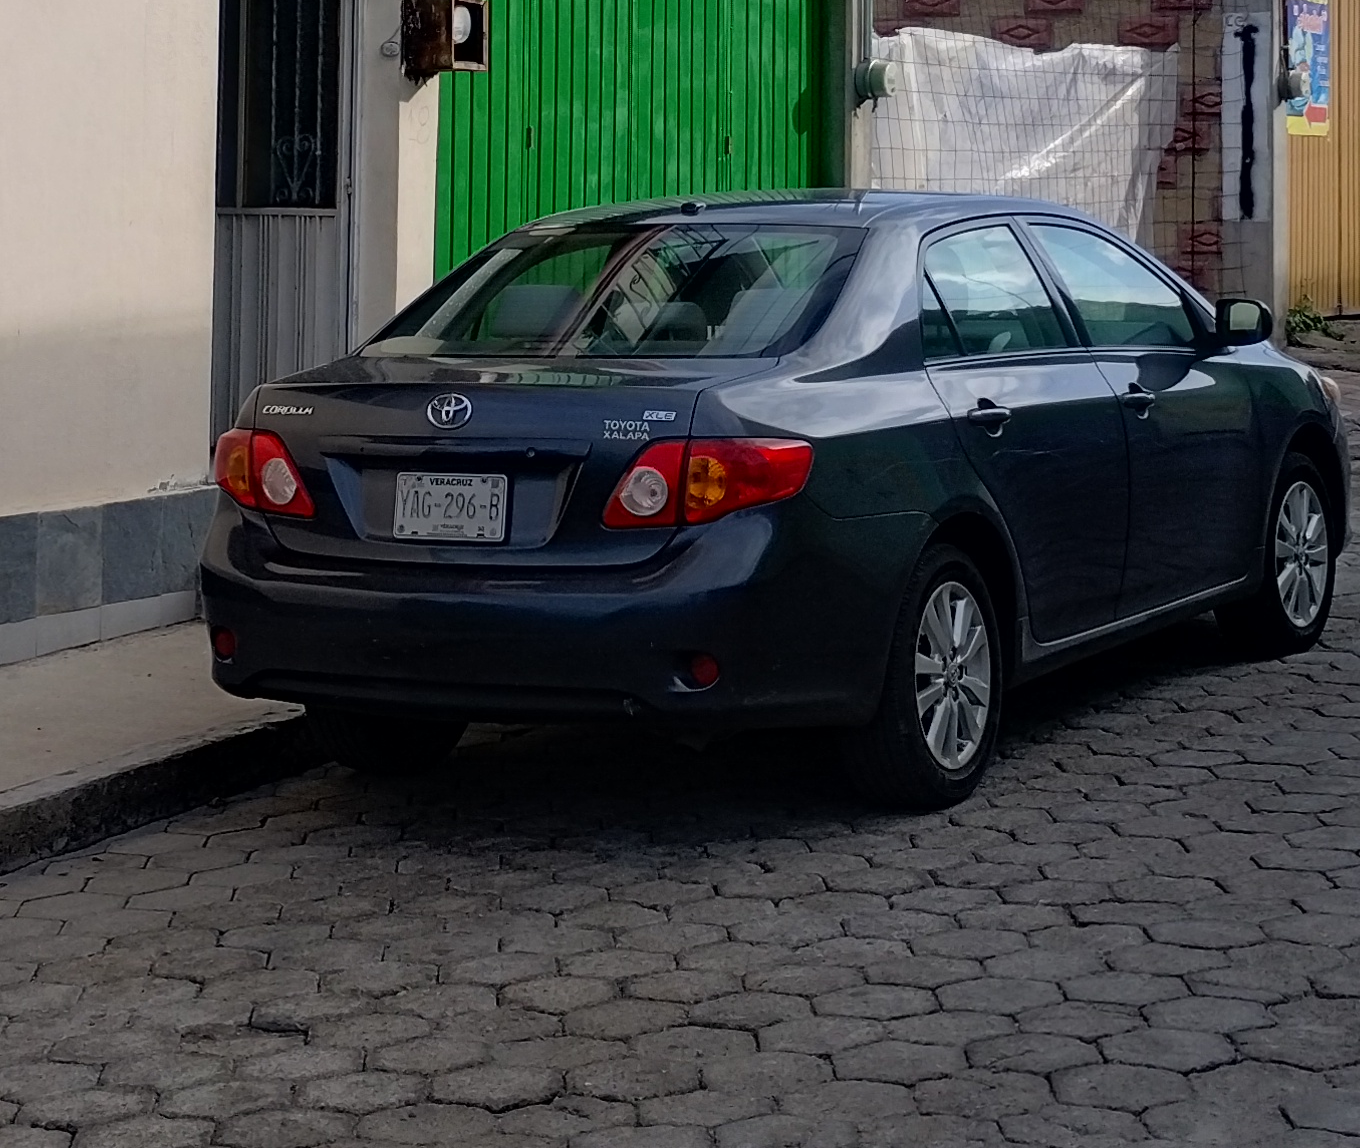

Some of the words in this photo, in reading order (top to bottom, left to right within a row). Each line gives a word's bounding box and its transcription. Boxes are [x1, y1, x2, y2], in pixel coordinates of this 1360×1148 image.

[645, 411, 675, 420] XLE
[603, 419, 650, 432] TOYOTA
[603, 431, 650, 441] XALAPA
[429, 477, 473, 487] VERACRUZ
[400, 489, 501, 522] YAG-296-B
